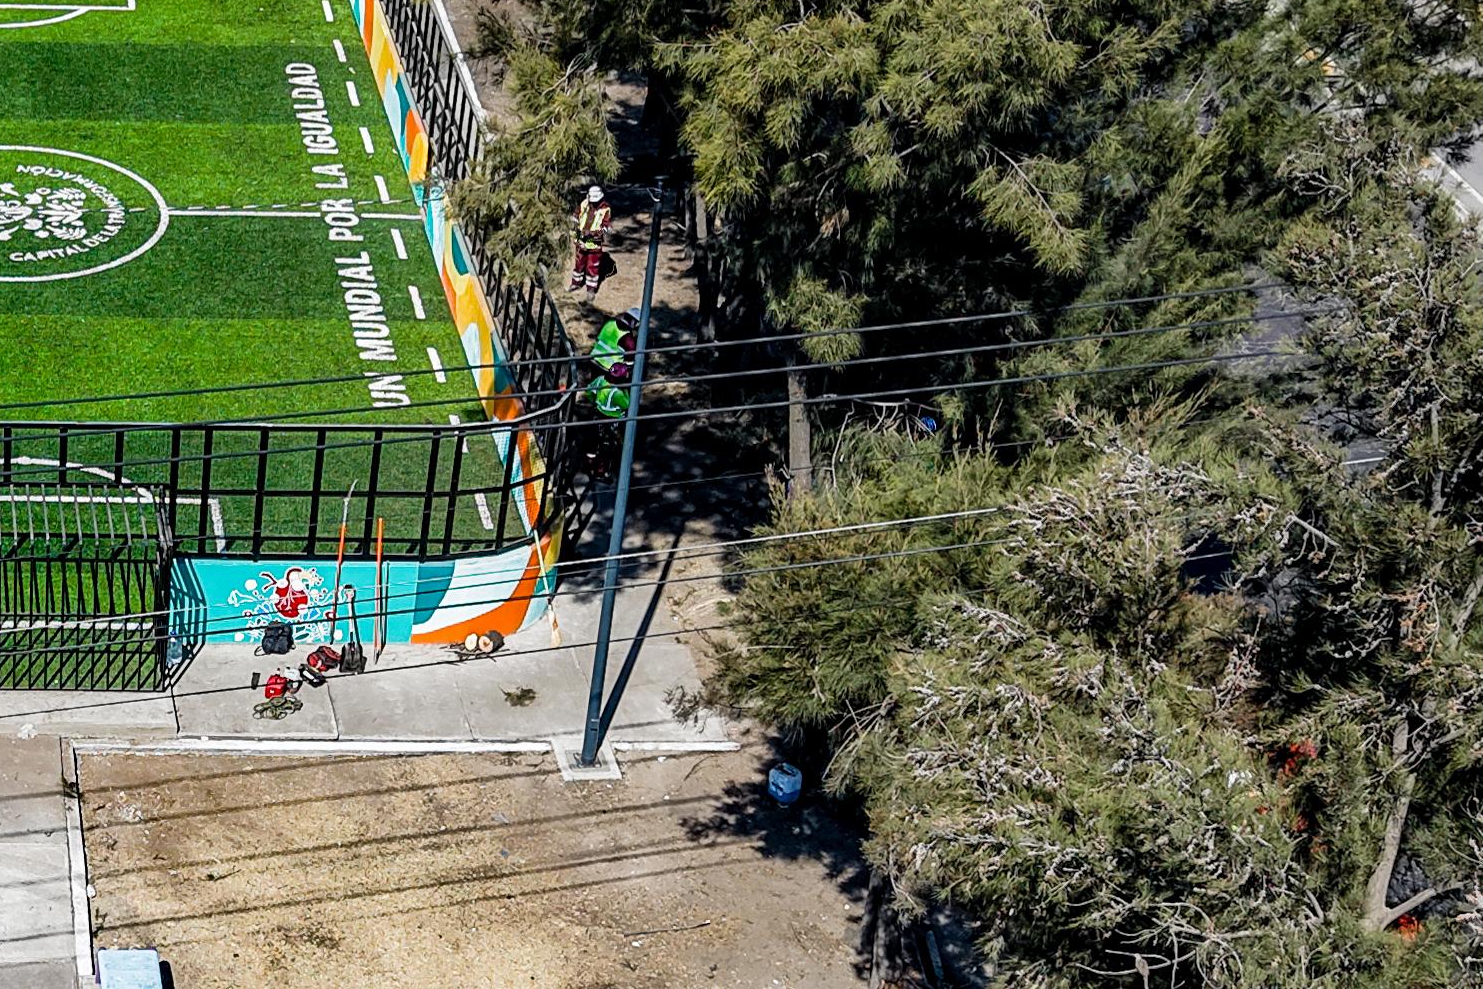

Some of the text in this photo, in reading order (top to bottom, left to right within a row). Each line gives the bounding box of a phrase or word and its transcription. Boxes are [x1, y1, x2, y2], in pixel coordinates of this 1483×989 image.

[9, 244, 90, 262] CAPITAL
[285, 62, 410, 409] UN MUNDIAL POR LA IGUALDAD
